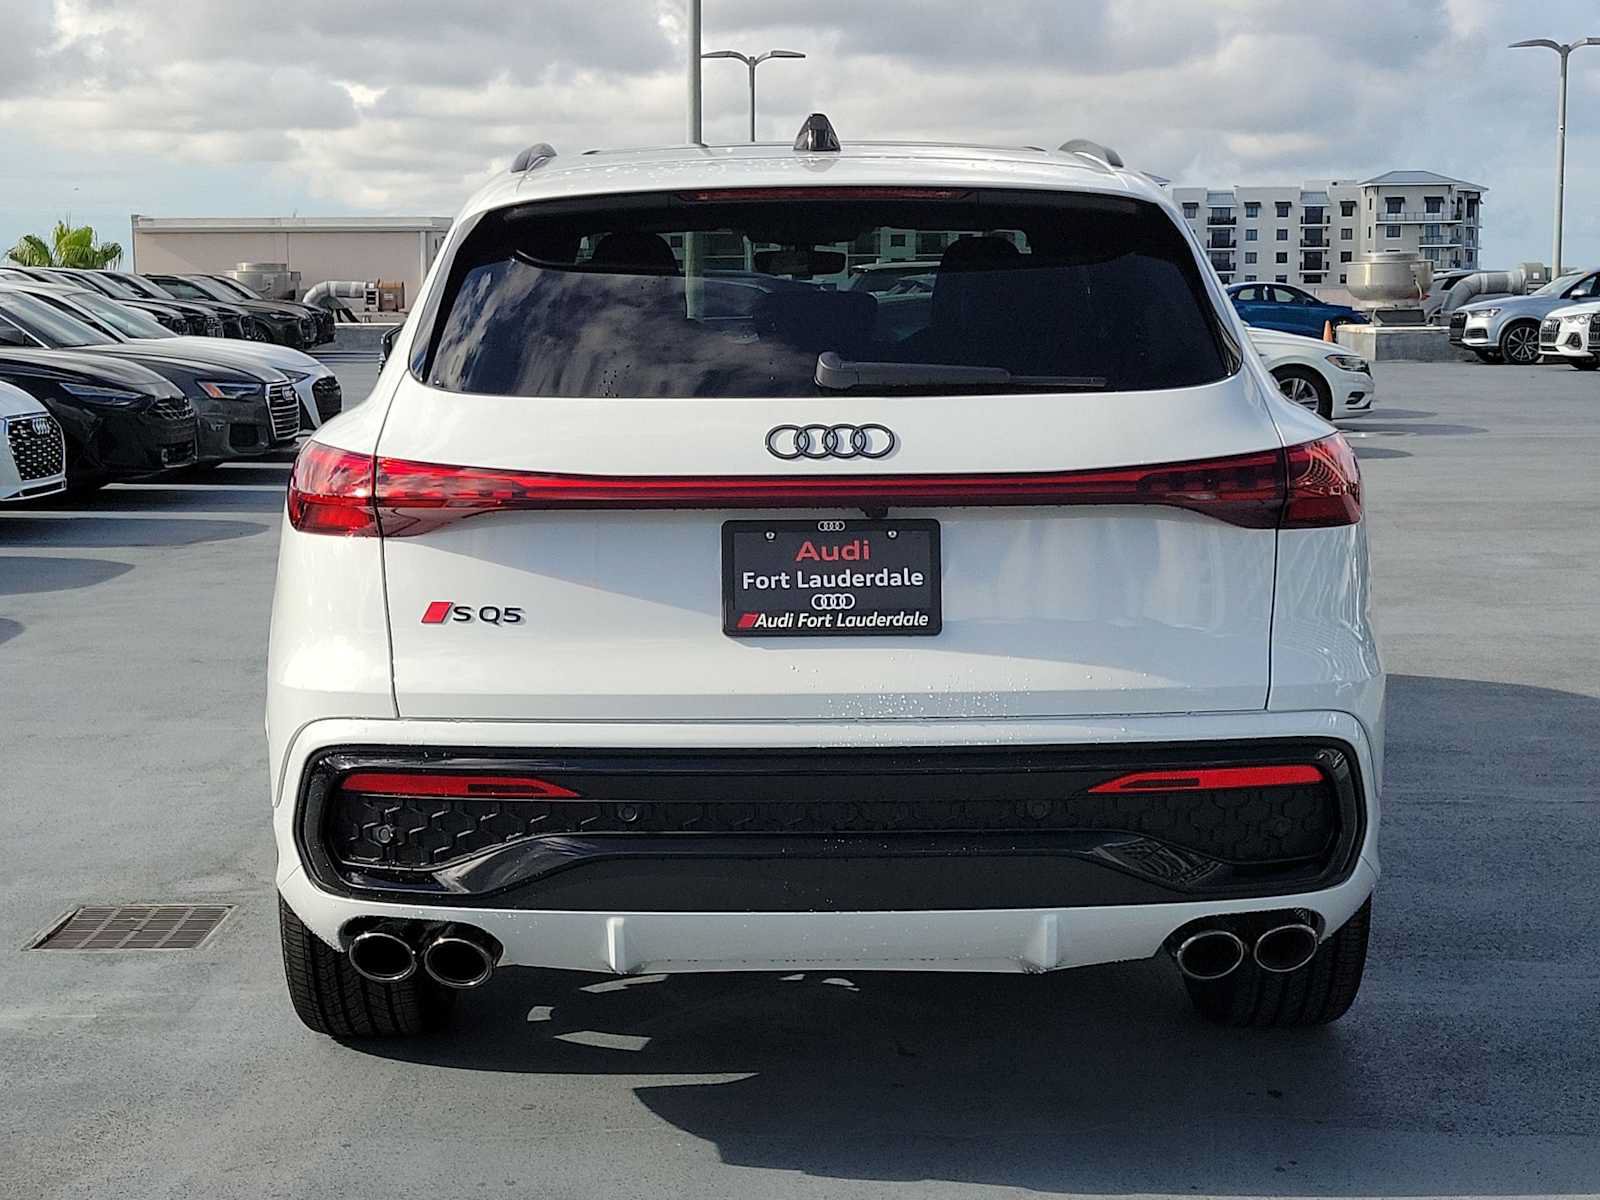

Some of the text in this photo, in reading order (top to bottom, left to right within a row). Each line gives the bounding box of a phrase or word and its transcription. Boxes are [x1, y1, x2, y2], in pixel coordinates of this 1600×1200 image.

[795, 540, 871, 562] Audi
[742, 568, 924, 590] Fort Lauderdale
[452, 606, 522, 627] SQ5
[754, 611, 929, 629] Audi Fort Lauderdale
